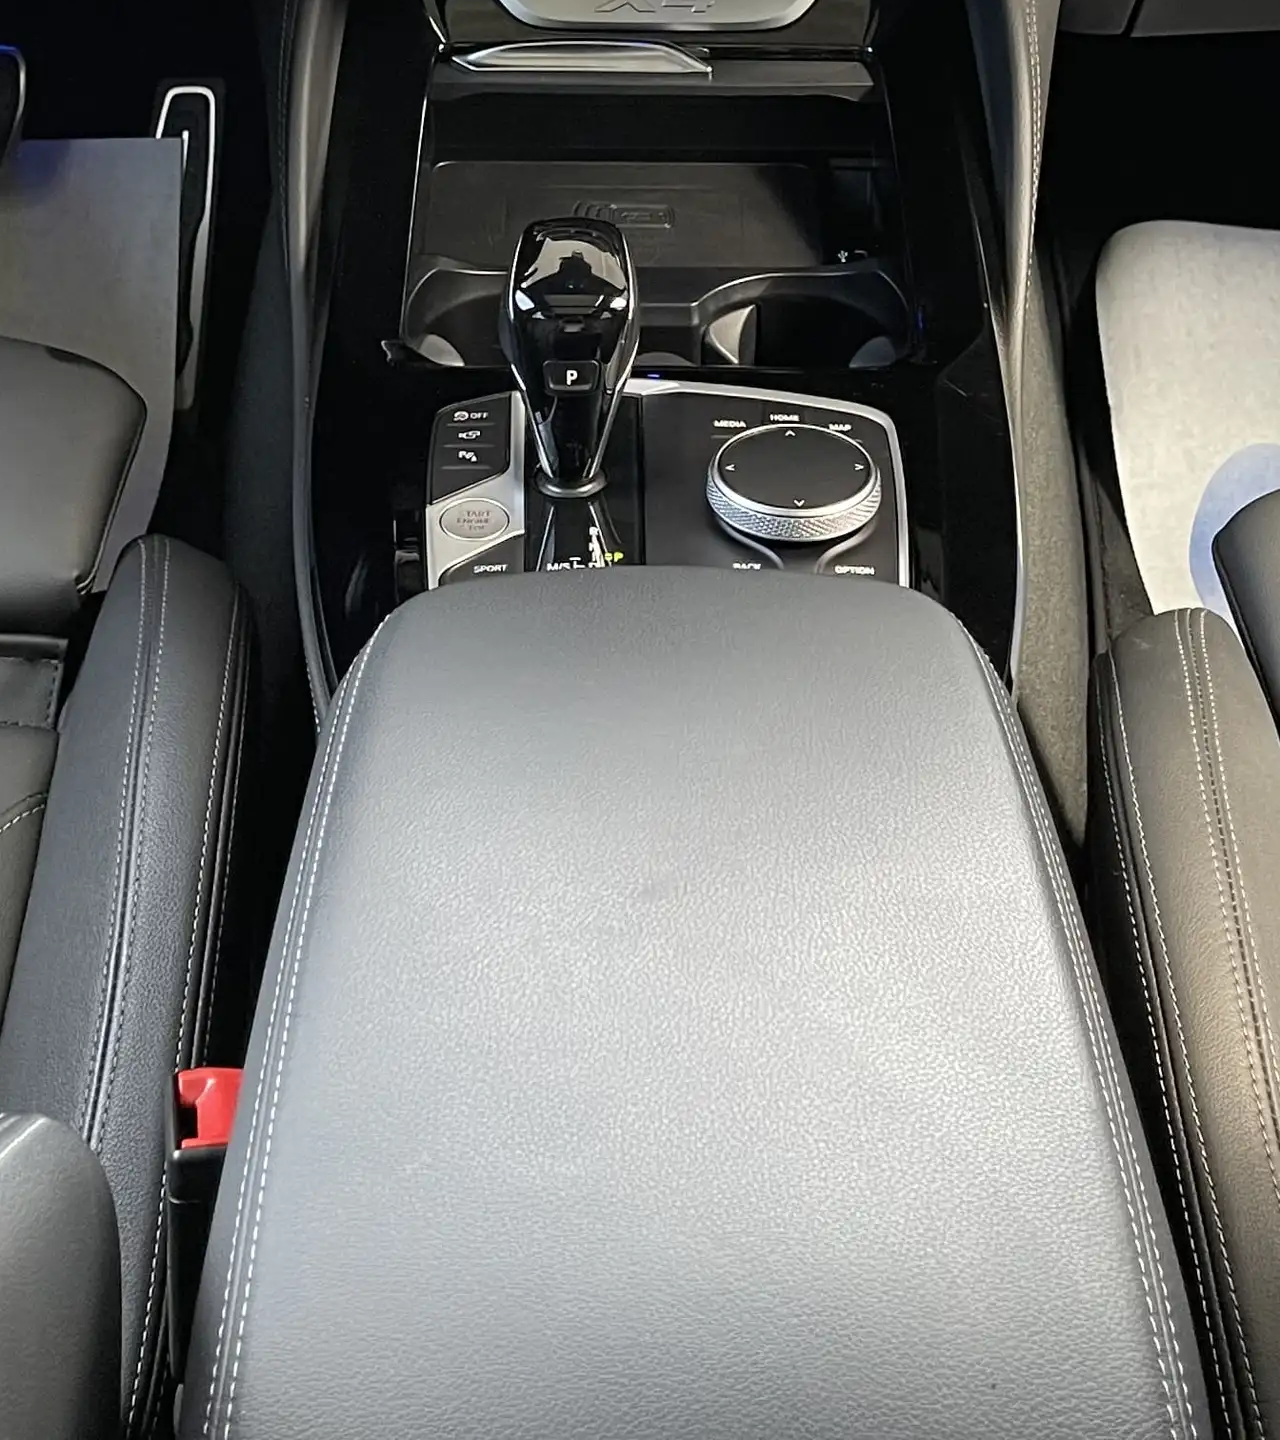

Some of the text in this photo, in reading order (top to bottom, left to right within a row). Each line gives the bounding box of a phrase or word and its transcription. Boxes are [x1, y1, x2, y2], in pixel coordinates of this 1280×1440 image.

[565, 369, 578, 386] P
[469, 411, 489, 420] OFF
[769, 414, 800, 423] HOME
[712, 419, 747, 429] MEDIA
[473, 563, 508, 573] SPORT
[834, 565, 876, 576] OPTION
